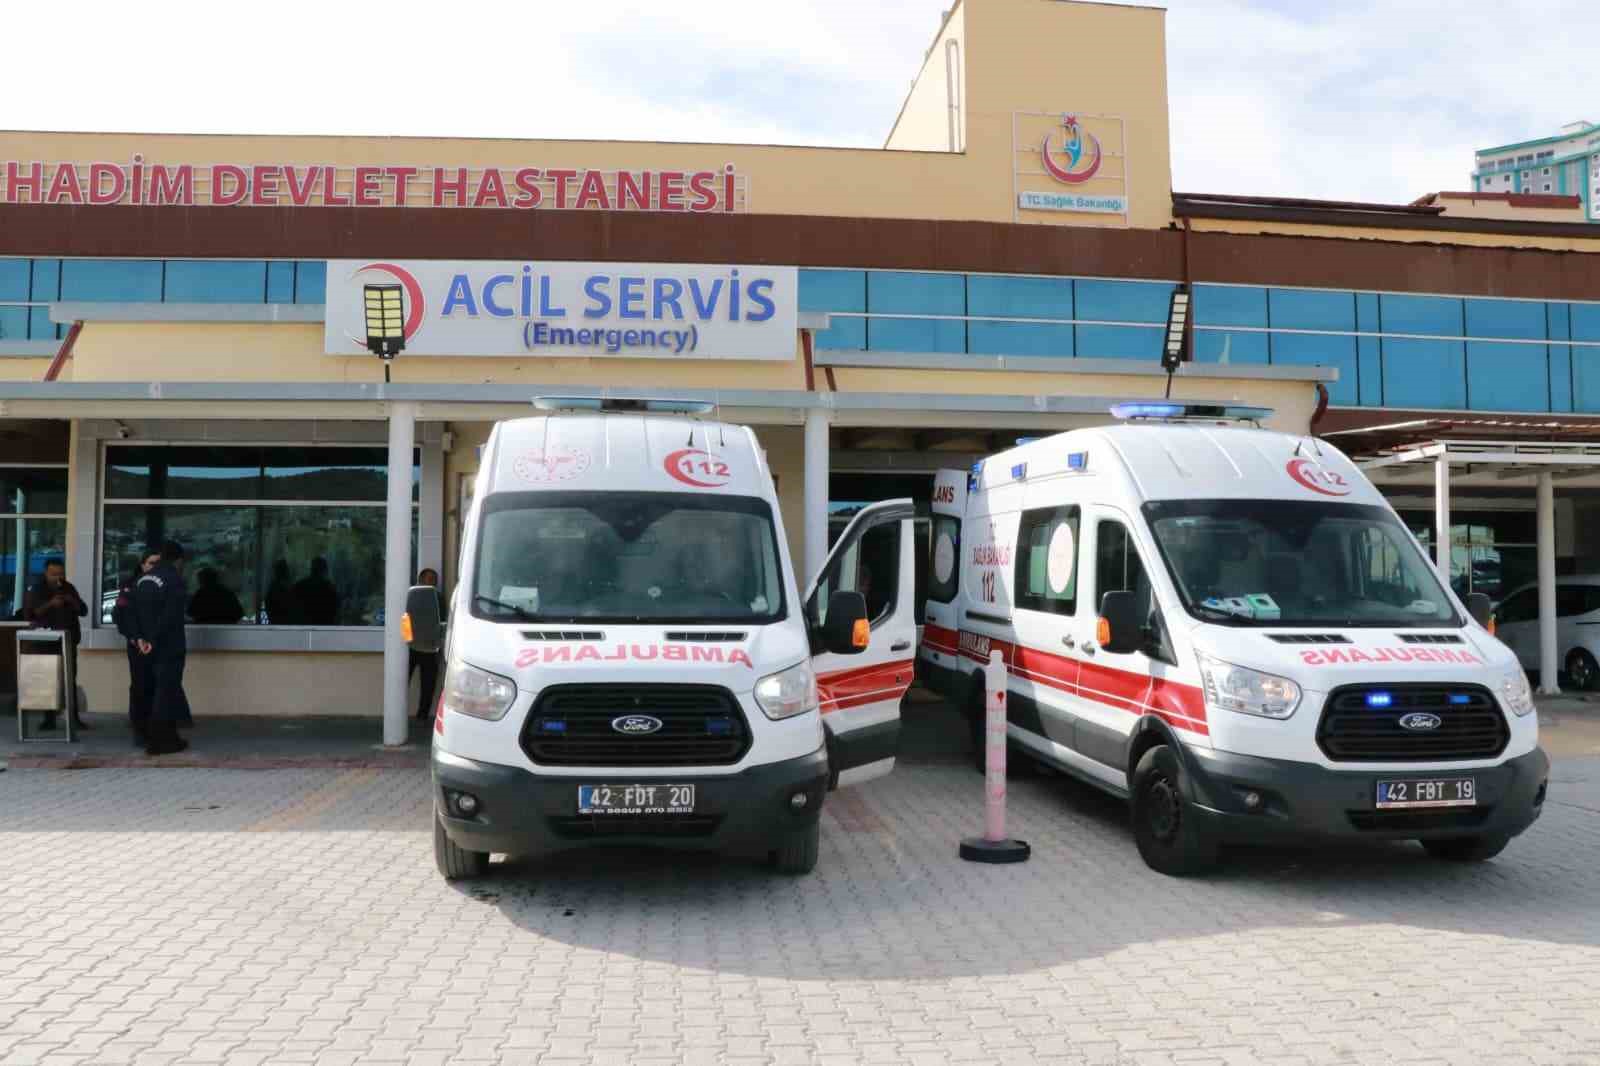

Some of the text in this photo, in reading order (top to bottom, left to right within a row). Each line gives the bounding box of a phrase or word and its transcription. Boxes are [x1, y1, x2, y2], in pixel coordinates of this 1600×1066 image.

[5, 152, 736, 214] HADİM DEVLET HASTANESİ
[440, 263, 777, 323] ACİL SERVİS
[523, 321, 699, 353] (Emergency)
[681, 460, 732, 477] 112
[1303, 468, 1349, 486] 112
[982, 570, 996, 603] 112
[623, 718, 651, 730] Ford
[1410, 715, 1434, 728] Ford
[590, 787, 611, 806] 42
[669, 786, 691, 807] 20
[1387, 782, 1408, 801] 42
[1455, 781, 1473, 799] 19
